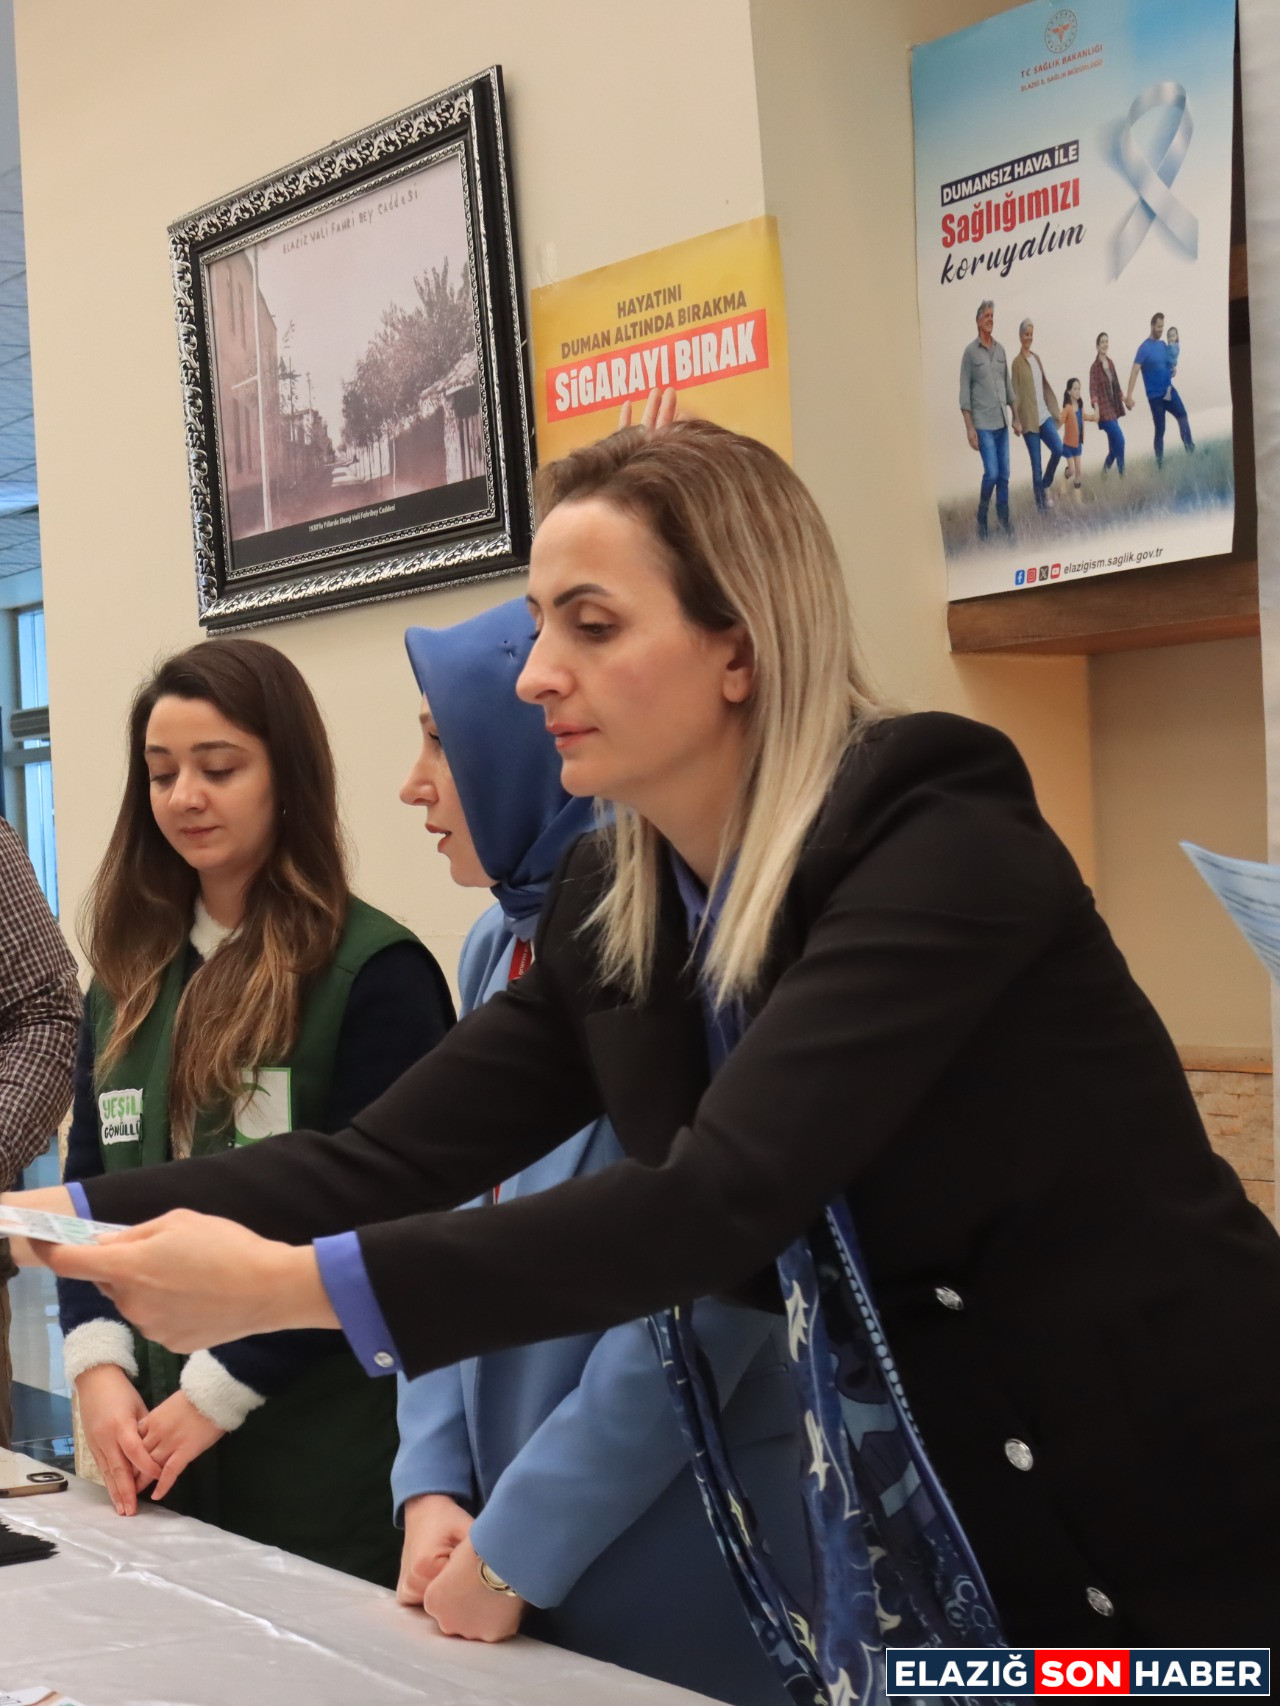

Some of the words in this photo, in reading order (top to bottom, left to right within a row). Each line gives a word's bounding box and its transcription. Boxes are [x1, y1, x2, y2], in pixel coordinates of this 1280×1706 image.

[942, 165, 1012, 204] DUMANSIZ
[1014, 153, 1052, 179] HAVA
[1054, 144, 1078, 166] İLE
[358, 208, 374, 224] BEY
[941, 177, 1080, 248] Sağlığımızı
[561, 329, 611, 360] DUMAN
[614, 312, 675, 345] ALTINDA
[677, 290, 747, 327] BIRAKMA
[617, 284, 682, 319] HAYATINI
[555, 344, 670, 413] SİGARAYI
[674, 320, 757, 382] BIRAK
[1063, 547, 1164, 574] elazigism.saglik.gov.tr
